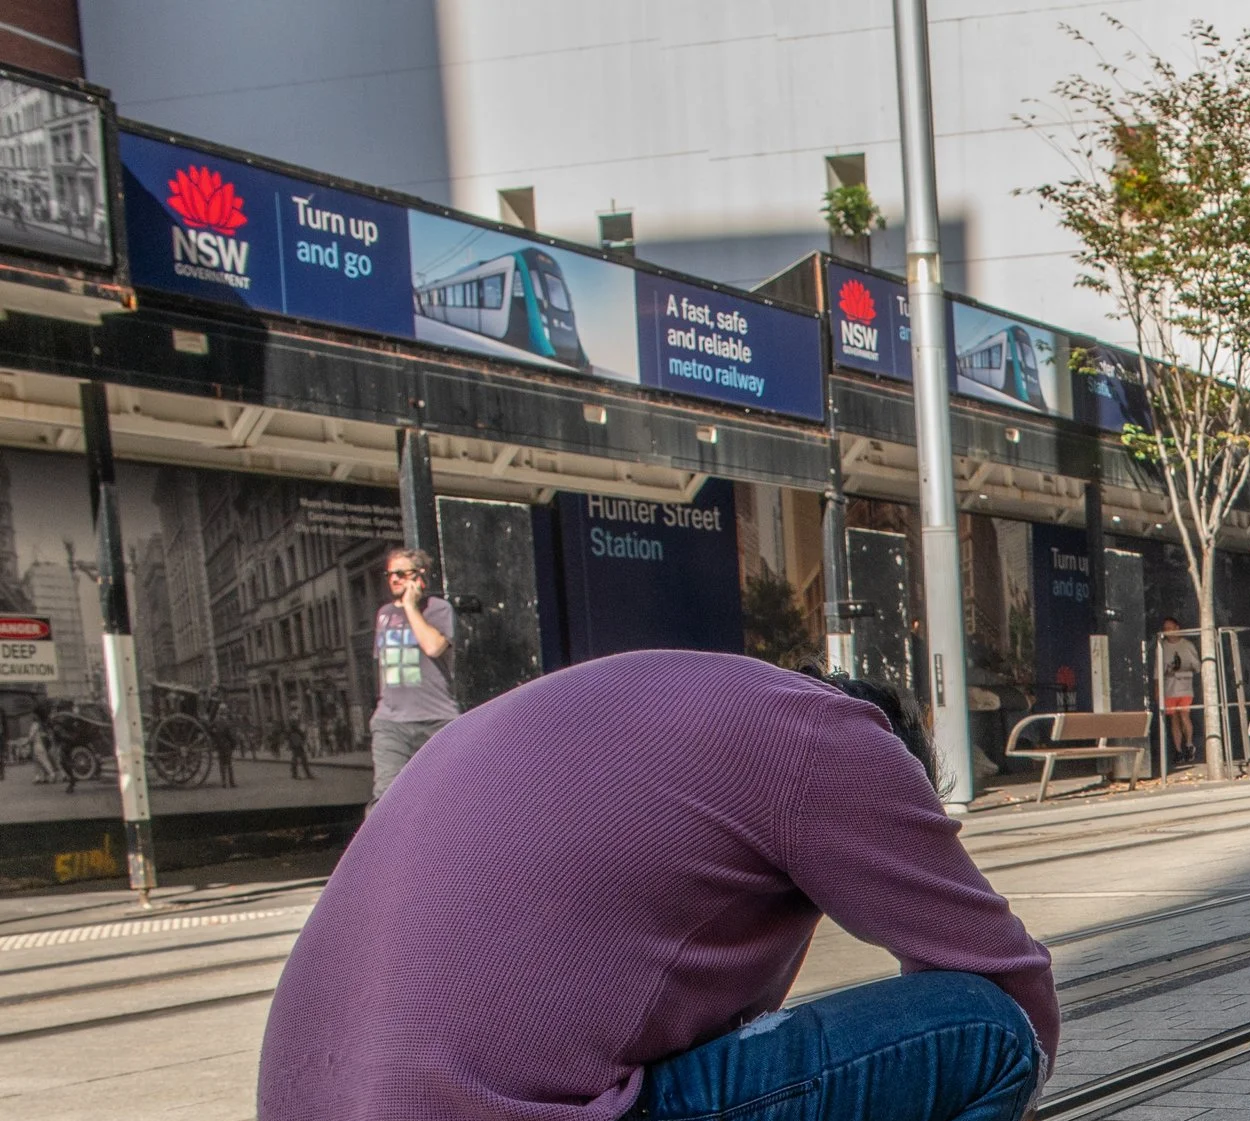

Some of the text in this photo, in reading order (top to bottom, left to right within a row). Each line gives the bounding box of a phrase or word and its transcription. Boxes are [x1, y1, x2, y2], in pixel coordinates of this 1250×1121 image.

[292, 196, 379, 246] Turn up
[172, 225, 249, 275] NSW
[296, 241, 372, 278] and go
[175, 263, 250, 289] GOVERNMENT
[666, 294, 748, 335] A fast, safe
[667, 328, 752, 363] and reliable
[841, 320, 878, 352] NSW
[669, 358, 765, 397] metro railway
[588, 493, 722, 531] Hunter Street
[590, 527, 664, 561] Station
[1051, 547, 1077, 570] Turn
[1052, 577, 1090, 601] and go
[1, 643, 37, 659] DEEP
[0, 663, 55, 676] CAVATION
